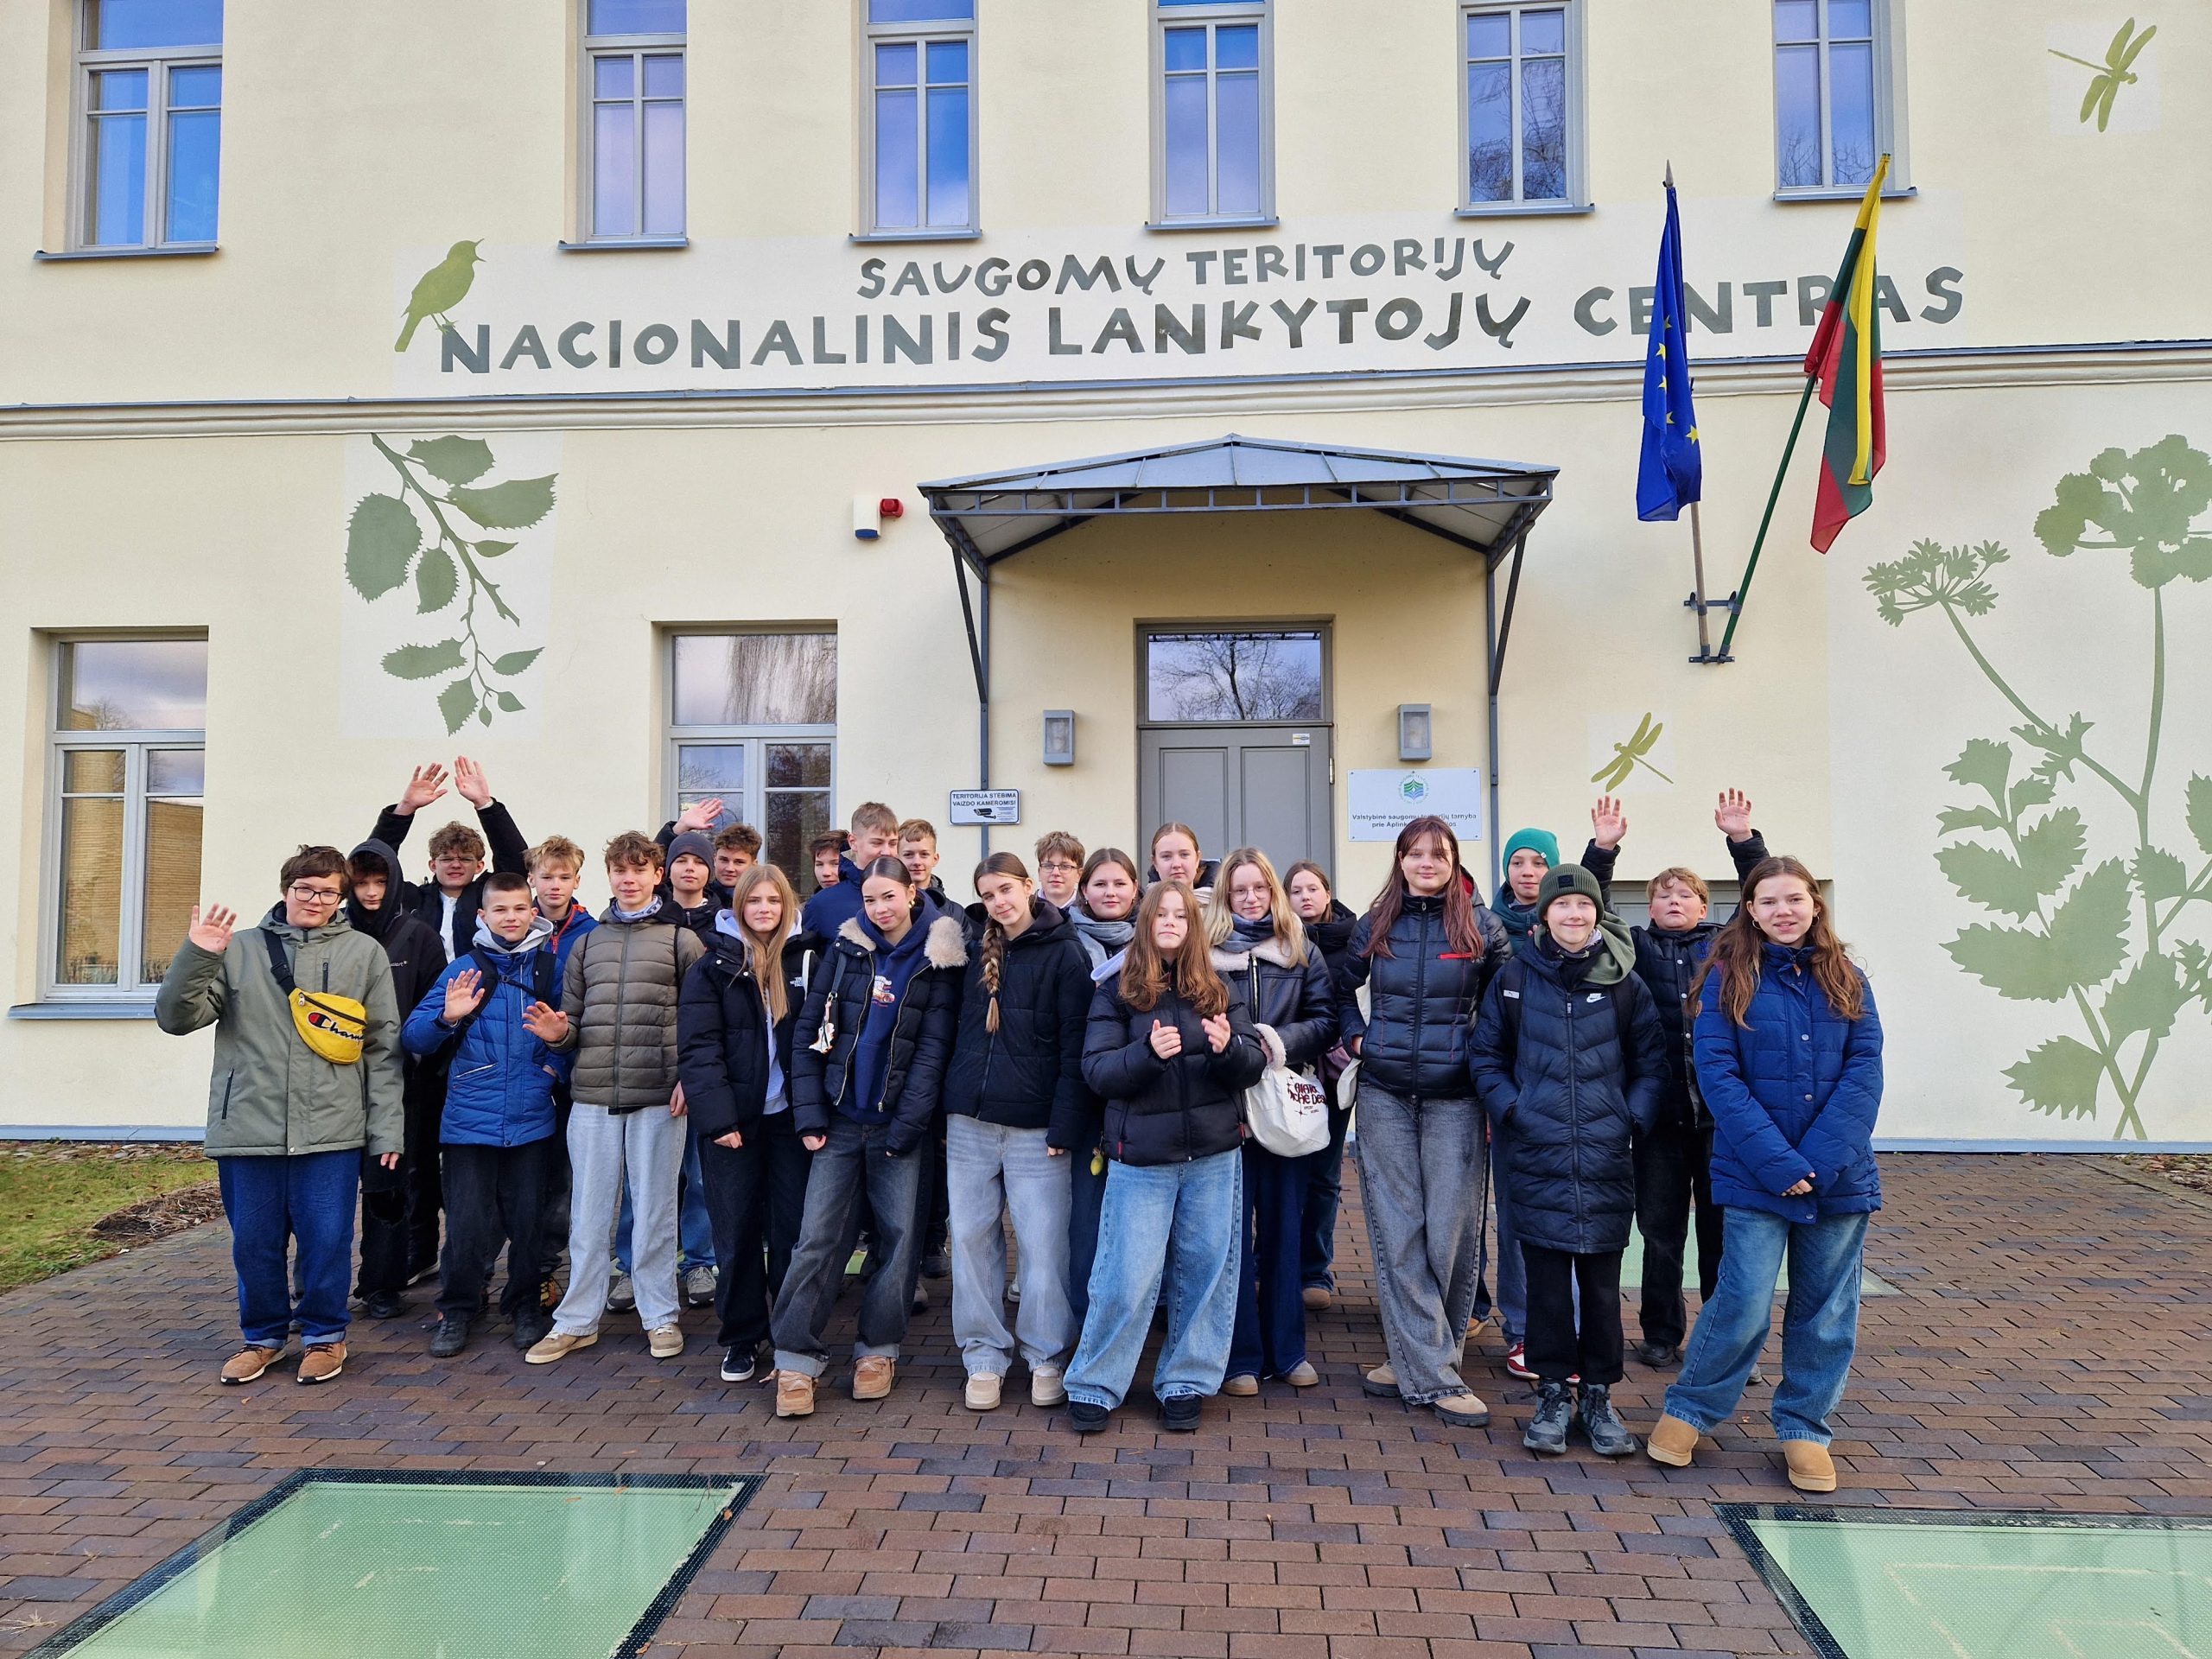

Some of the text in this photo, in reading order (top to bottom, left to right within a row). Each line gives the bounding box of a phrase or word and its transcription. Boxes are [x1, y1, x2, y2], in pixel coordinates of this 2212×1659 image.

[856, 237, 1516, 300] SAUGOMŲ TERITORIJŲ
[442, 266, 1964, 374] NACIONALINIS LANKYTOJŲ CENTRAS
